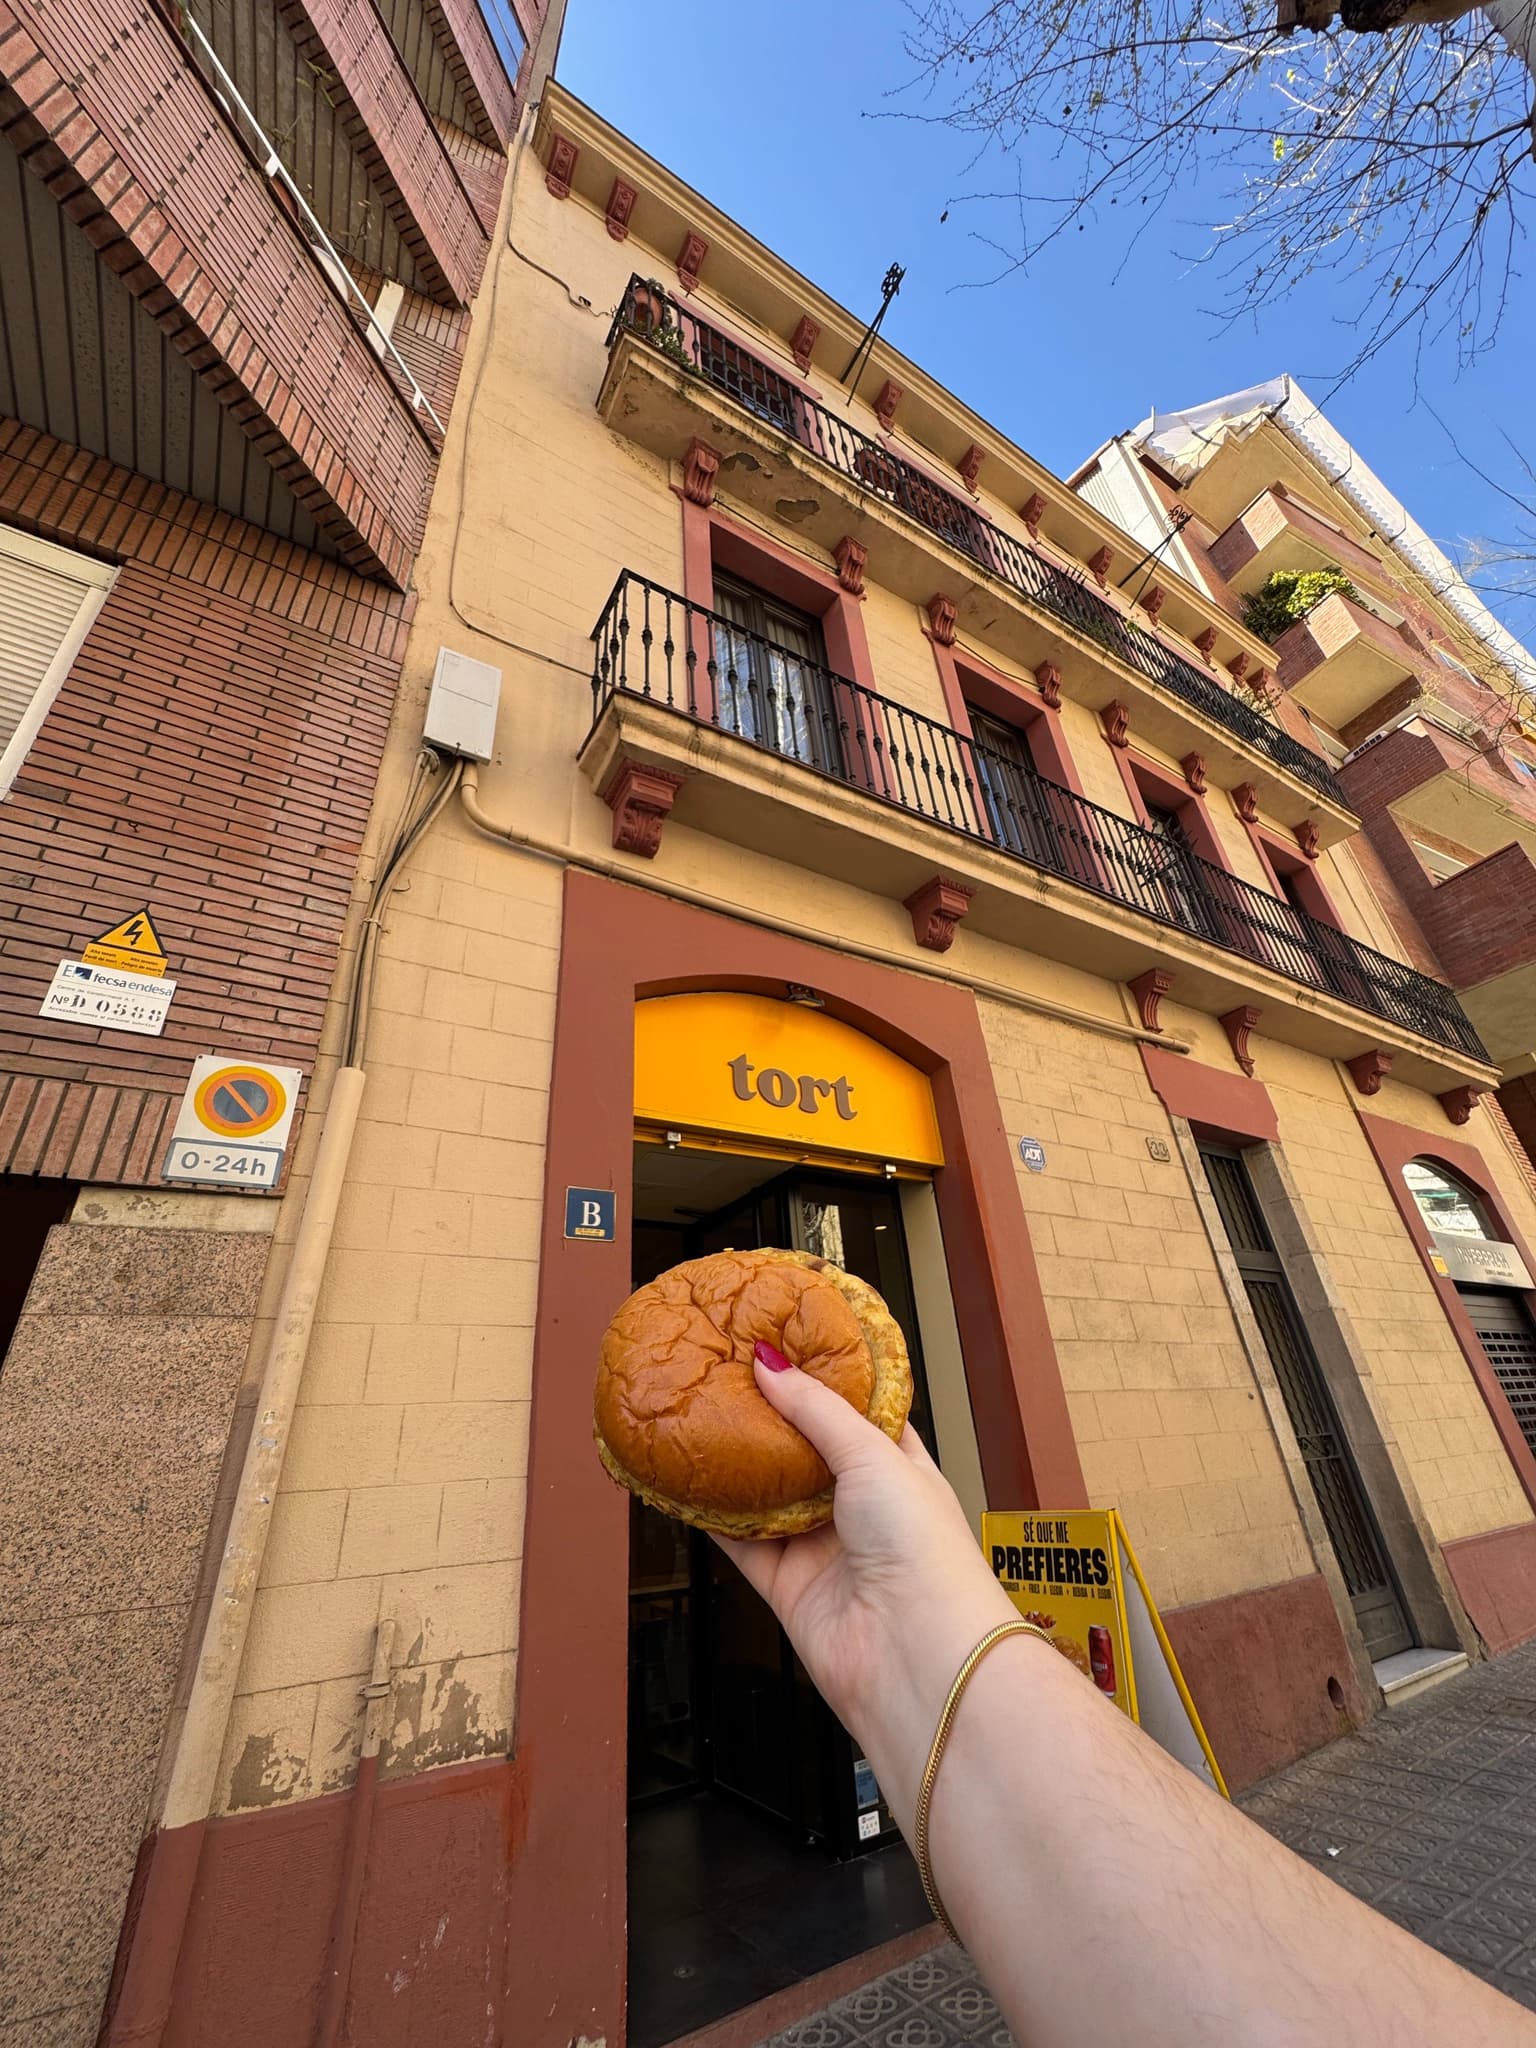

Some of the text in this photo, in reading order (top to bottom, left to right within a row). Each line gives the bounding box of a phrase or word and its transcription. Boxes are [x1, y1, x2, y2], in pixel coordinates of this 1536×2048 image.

[93, 973, 127, 988] fecsa
[128, 980, 172, 997] endesa
[727, 1053, 858, 1120] tort
[180, 1151, 266, 1176] 0-24h
[1024, 1146, 1042, 1161] ADT
[580, 1200, 601, 1227] B
[1023, 1516, 1070, 1544] SÉ QUE ME
[992, 1545, 1109, 1586] PREFIERES
